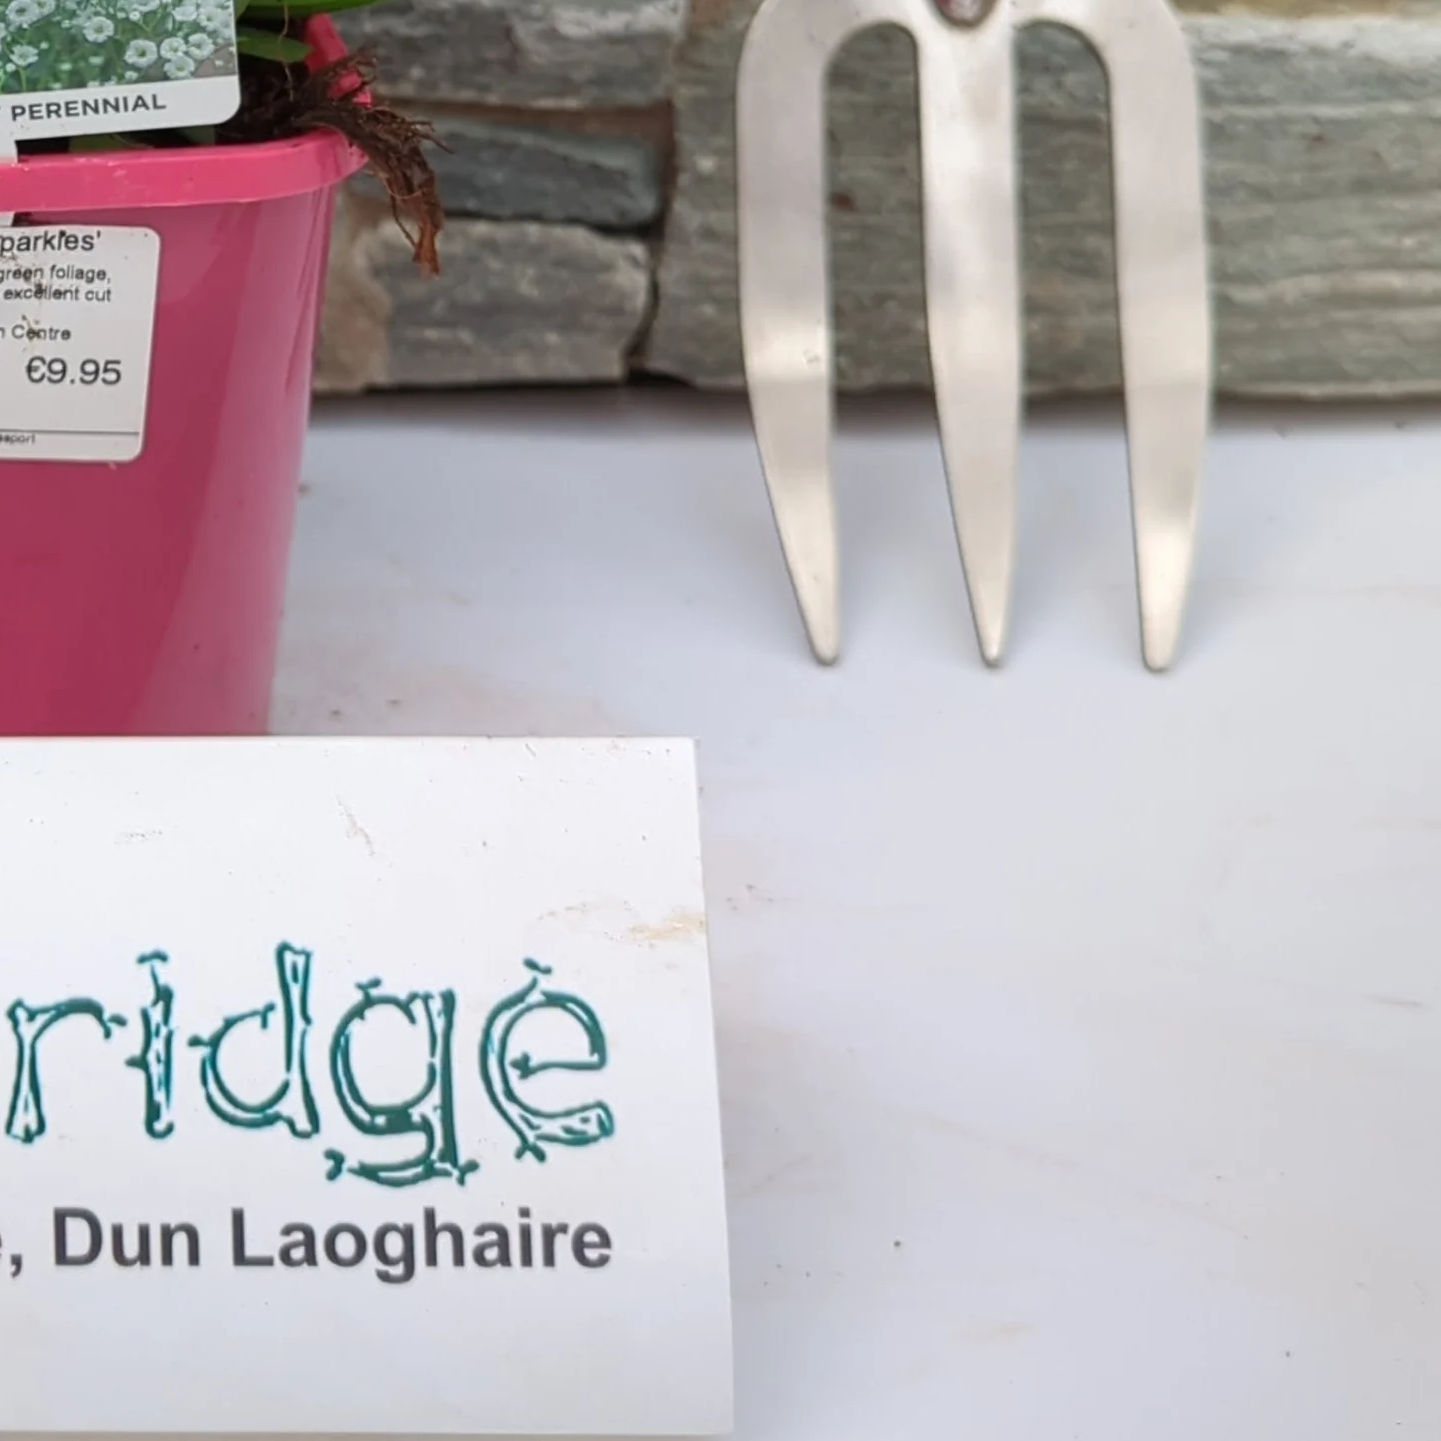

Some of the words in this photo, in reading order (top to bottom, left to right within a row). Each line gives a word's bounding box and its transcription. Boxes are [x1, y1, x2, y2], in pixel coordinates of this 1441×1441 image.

[11, 93, 168, 122] PERENNIAL
[50, 264, 111, 285] foliage,
[3, 284, 79, 301] excellent
[85, 288, 111, 302] cut
[12, 323, 72, 341] Centre
[26, 355, 122, 386] €9.95
[53, 1207, 201, 1268] Dun
[231, 1207, 613, 1284] Laoghaire
